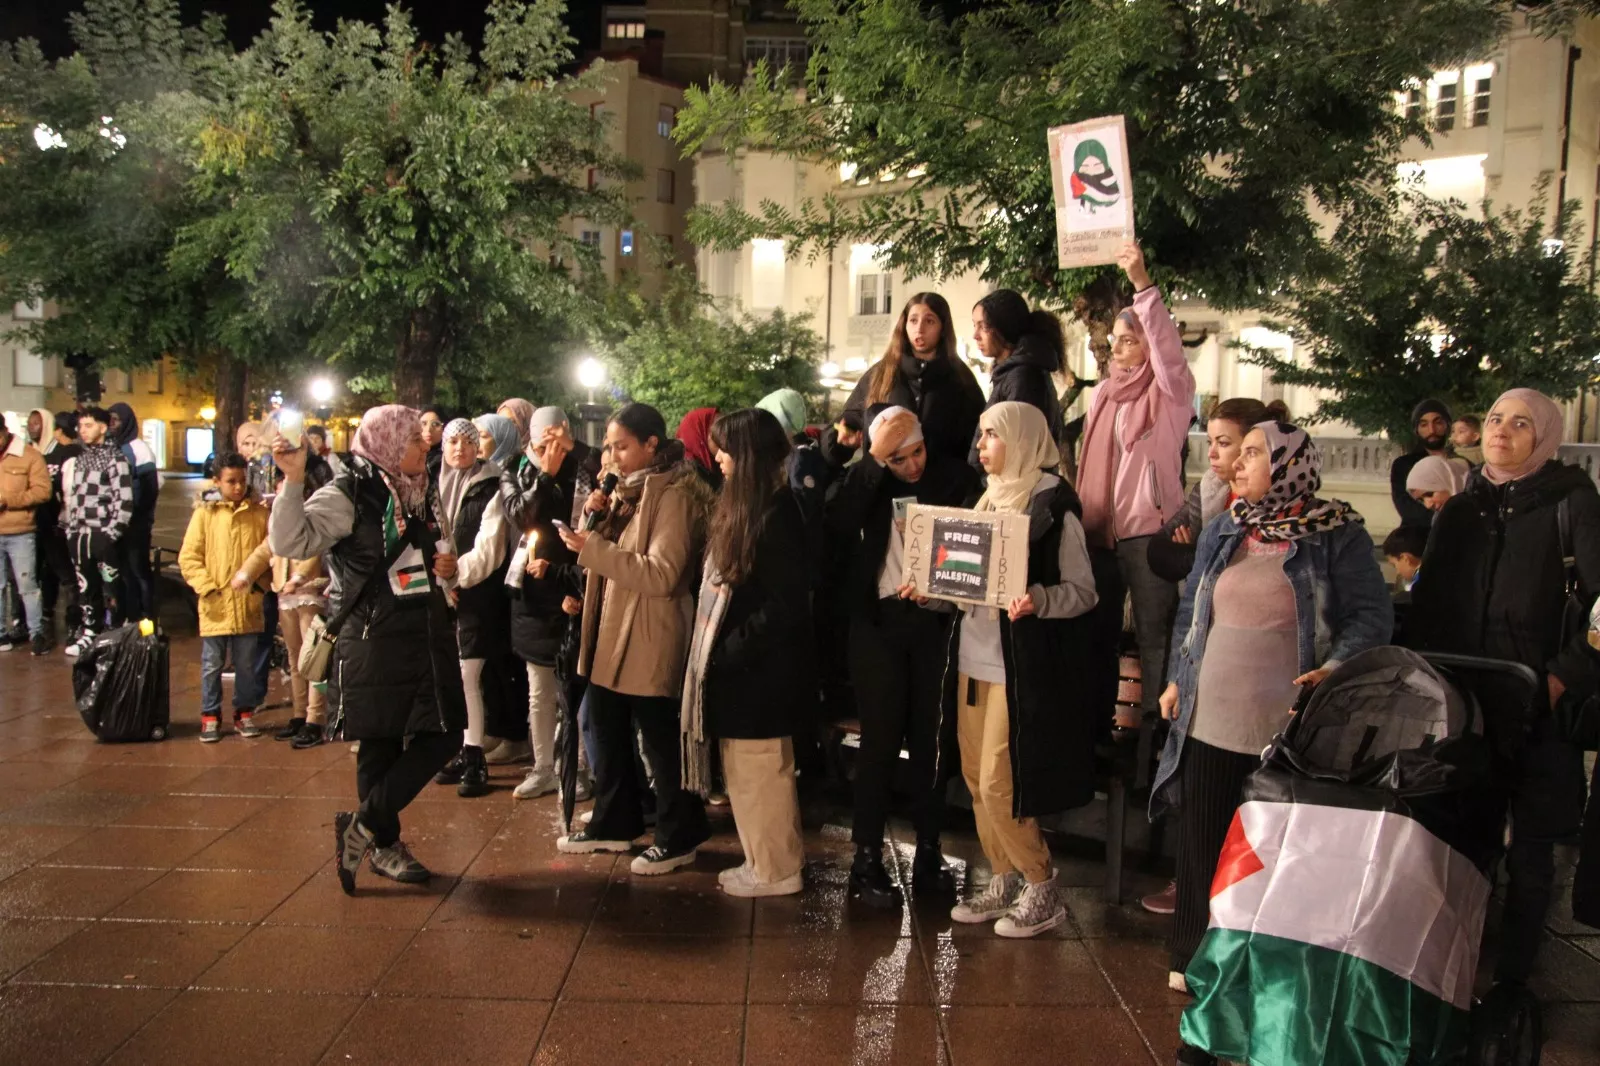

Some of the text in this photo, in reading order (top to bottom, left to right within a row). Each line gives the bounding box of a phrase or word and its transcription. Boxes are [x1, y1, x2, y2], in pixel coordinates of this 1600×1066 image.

[943, 531, 980, 545] FREE
[907, 513, 924, 588] GAZA
[935, 570, 981, 586] PALESTINE
